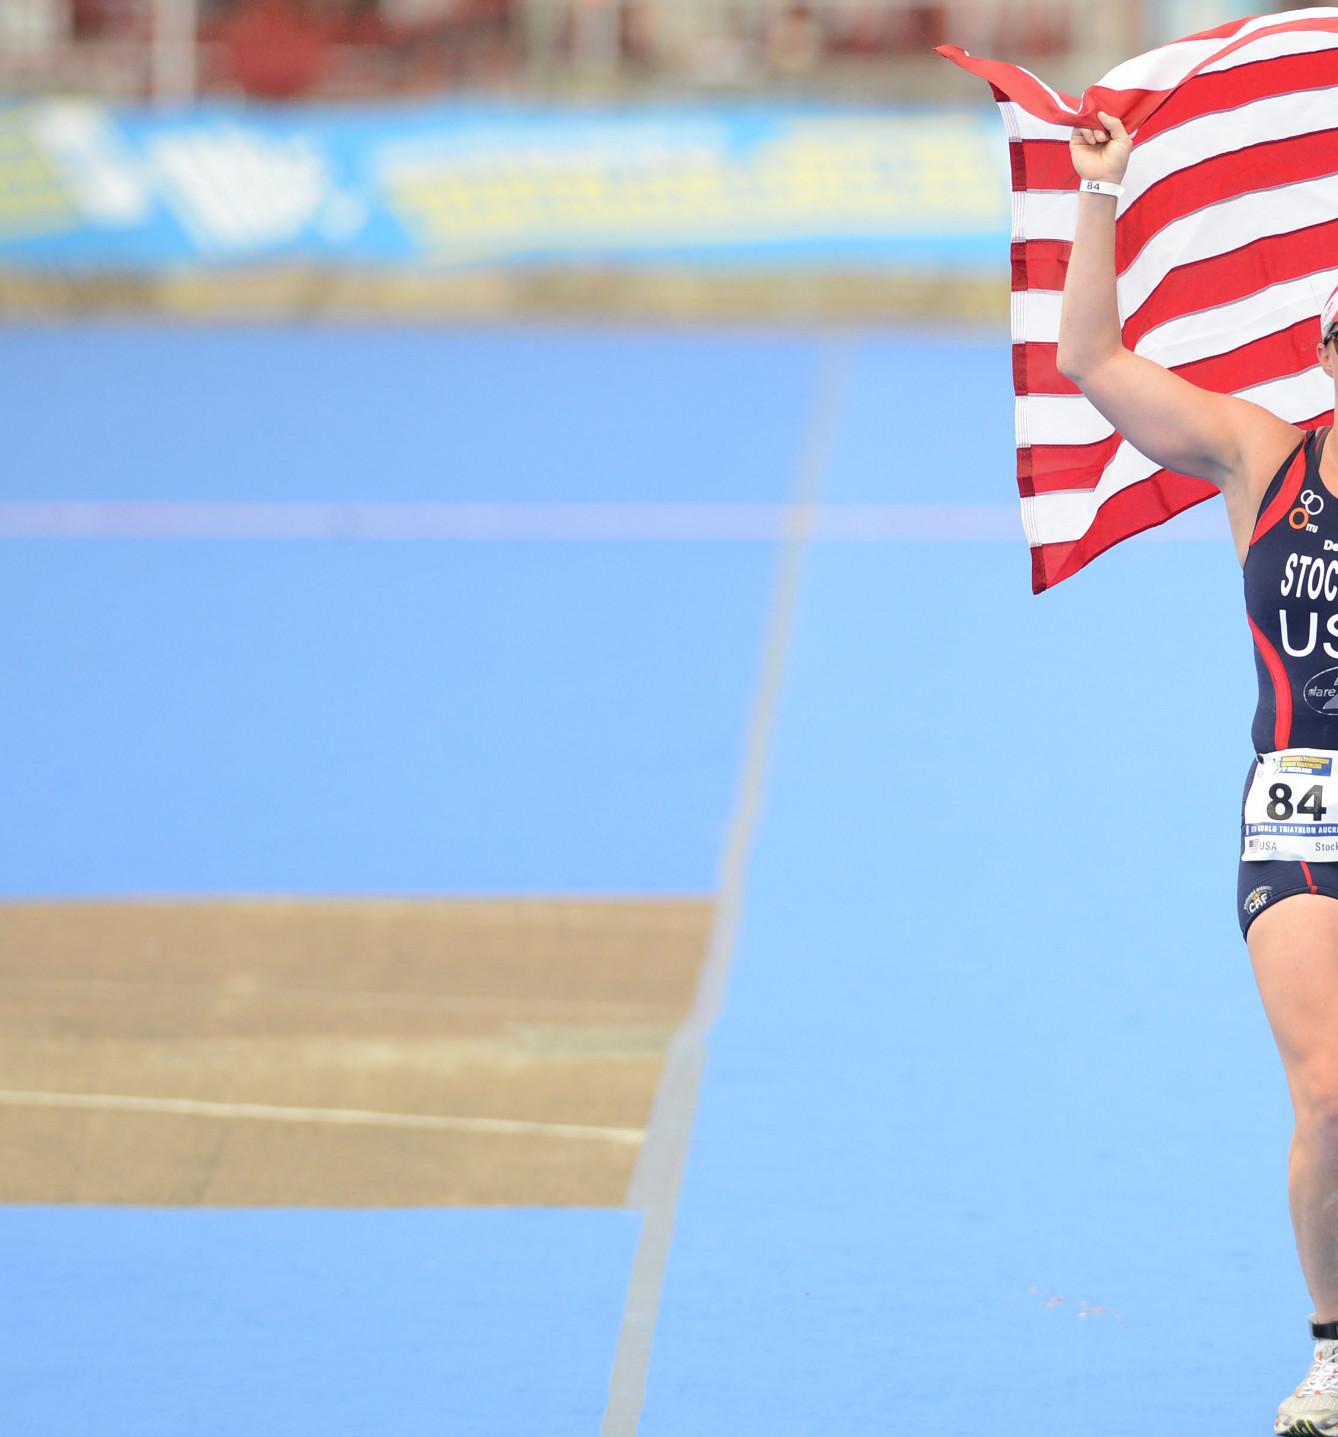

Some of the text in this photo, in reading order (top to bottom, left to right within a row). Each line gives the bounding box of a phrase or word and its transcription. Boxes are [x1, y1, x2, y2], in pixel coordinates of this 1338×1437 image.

[1087, 181, 1100, 190] 84
[1305, 523, 1319, 533] ITU
[1266, 782, 1327, 821] 84
[1279, 826, 1317, 834] TRIATHLON
[1259, 841, 1277, 851] USA
